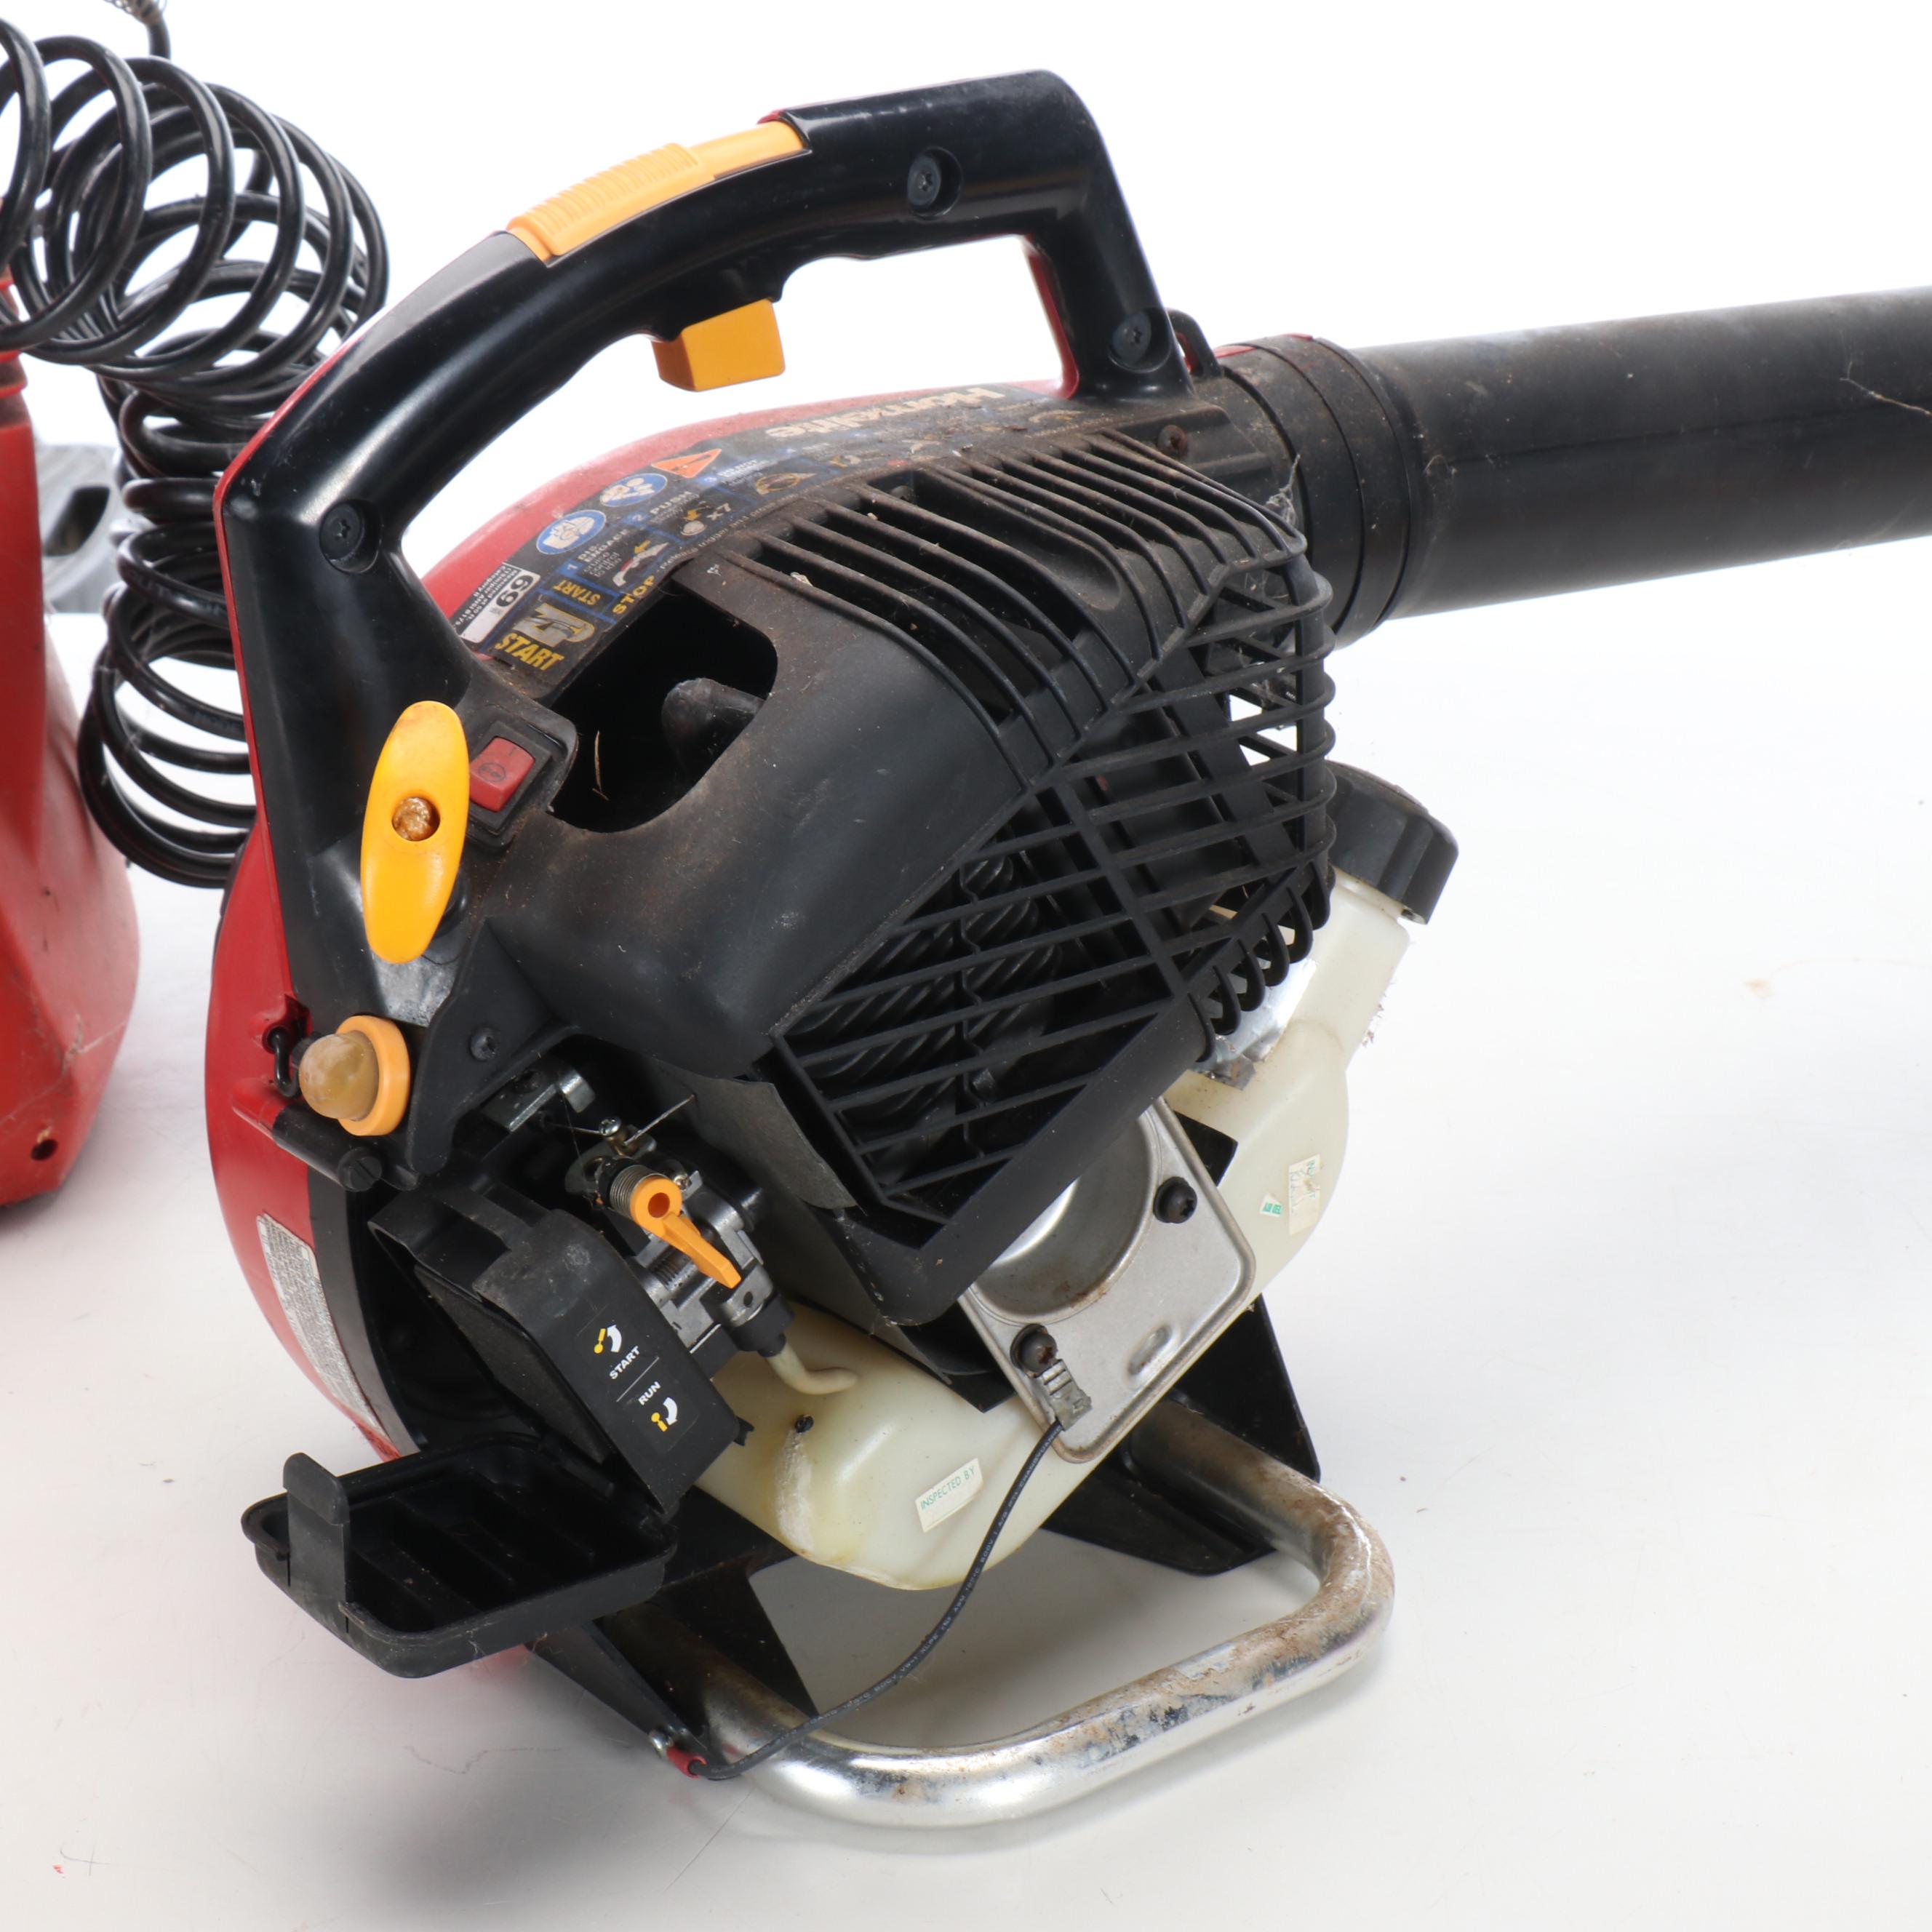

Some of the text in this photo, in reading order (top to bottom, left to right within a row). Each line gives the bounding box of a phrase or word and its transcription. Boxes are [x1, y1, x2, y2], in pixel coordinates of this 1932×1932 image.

[478, 566, 506, 591] Category
[488, 570, 518, 599] Measured
[496, 575, 534, 607] 69
[553, 580, 601, 605] START
[481, 598, 489, 606] at
[612, 575, 655, 614] STOP
[474, 605, 482, 614] 50
[495, 632, 565, 671] START
[609, 1346, 640, 1380] START
[638, 1381, 661, 1405] RUN
[920, 1466, 975, 1510] INSPECTED BY
